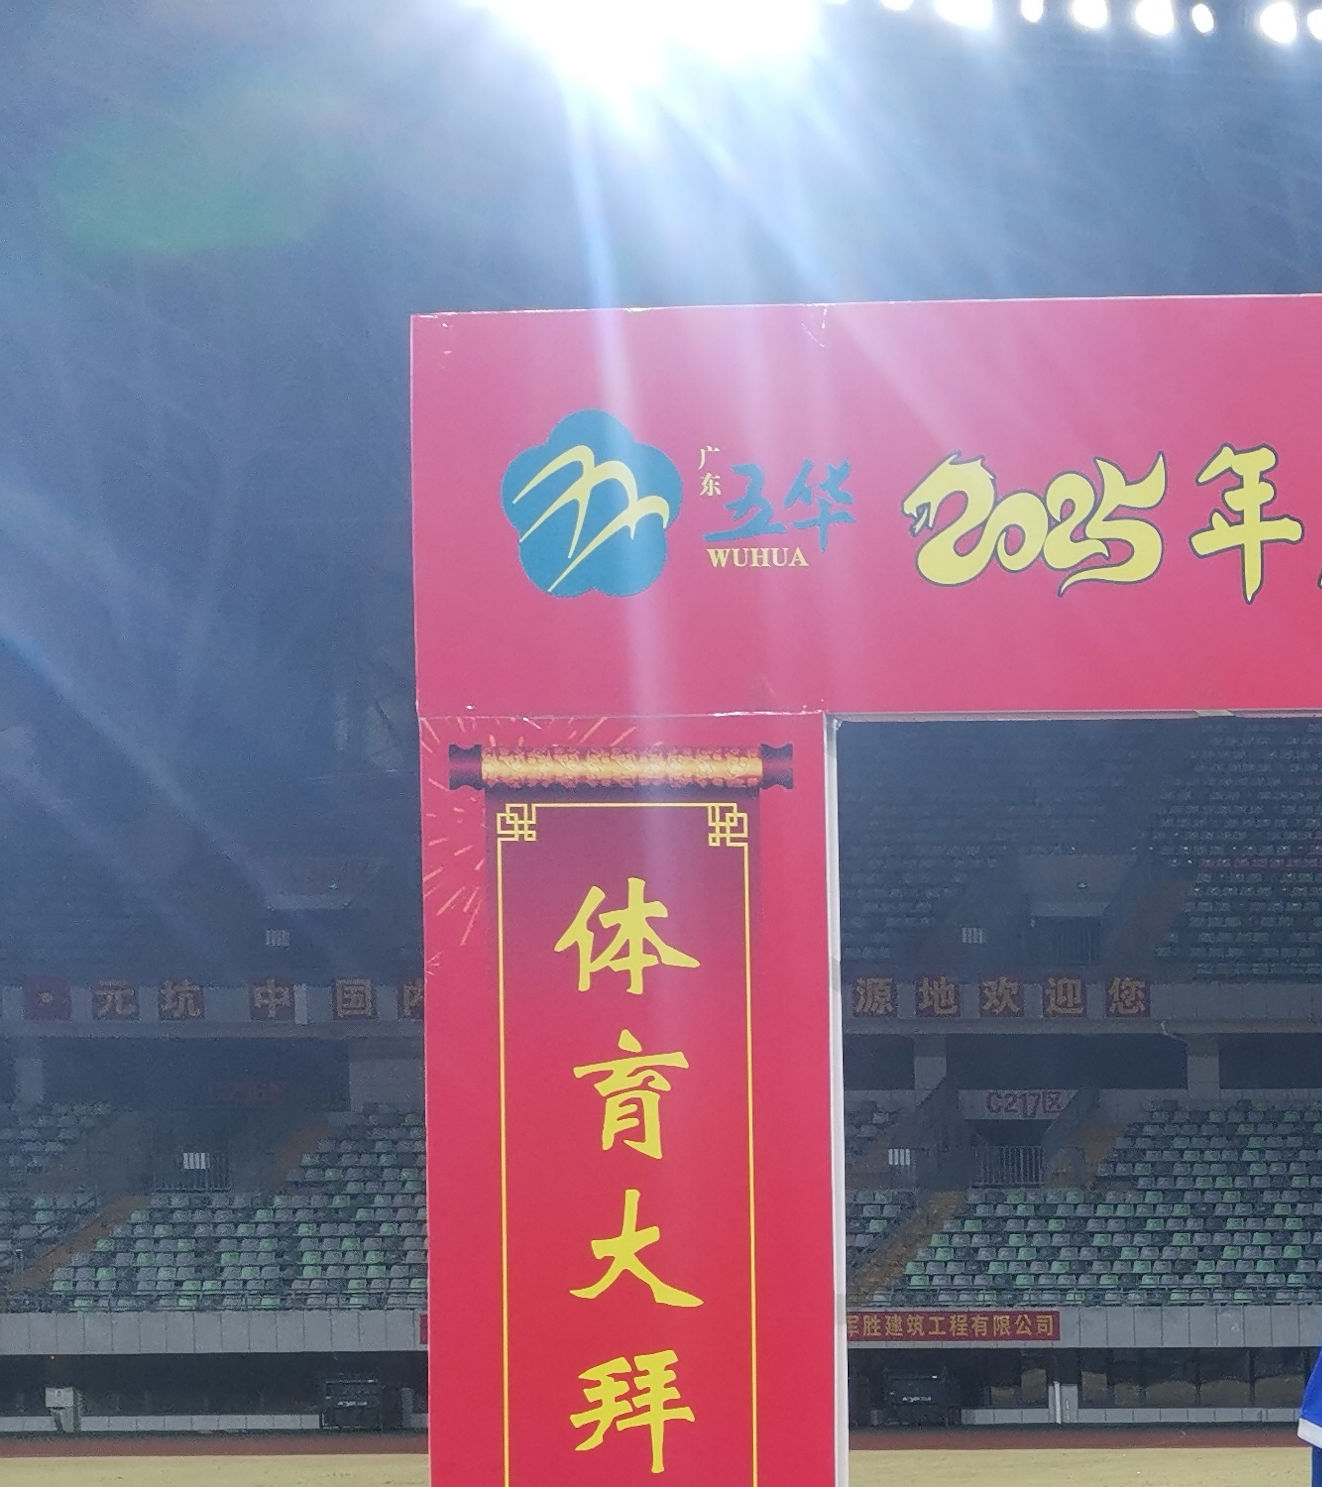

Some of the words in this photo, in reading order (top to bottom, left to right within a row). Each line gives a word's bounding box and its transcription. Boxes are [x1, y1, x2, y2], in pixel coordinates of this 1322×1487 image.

[699, 444, 721, 497] 广东
[704, 457, 857, 553] 五华
[706, 547, 809, 570] WUHUA
[852, 975, 1147, 1018] 源地欢迎您
[986, 1090, 1065, 1115] C217区
